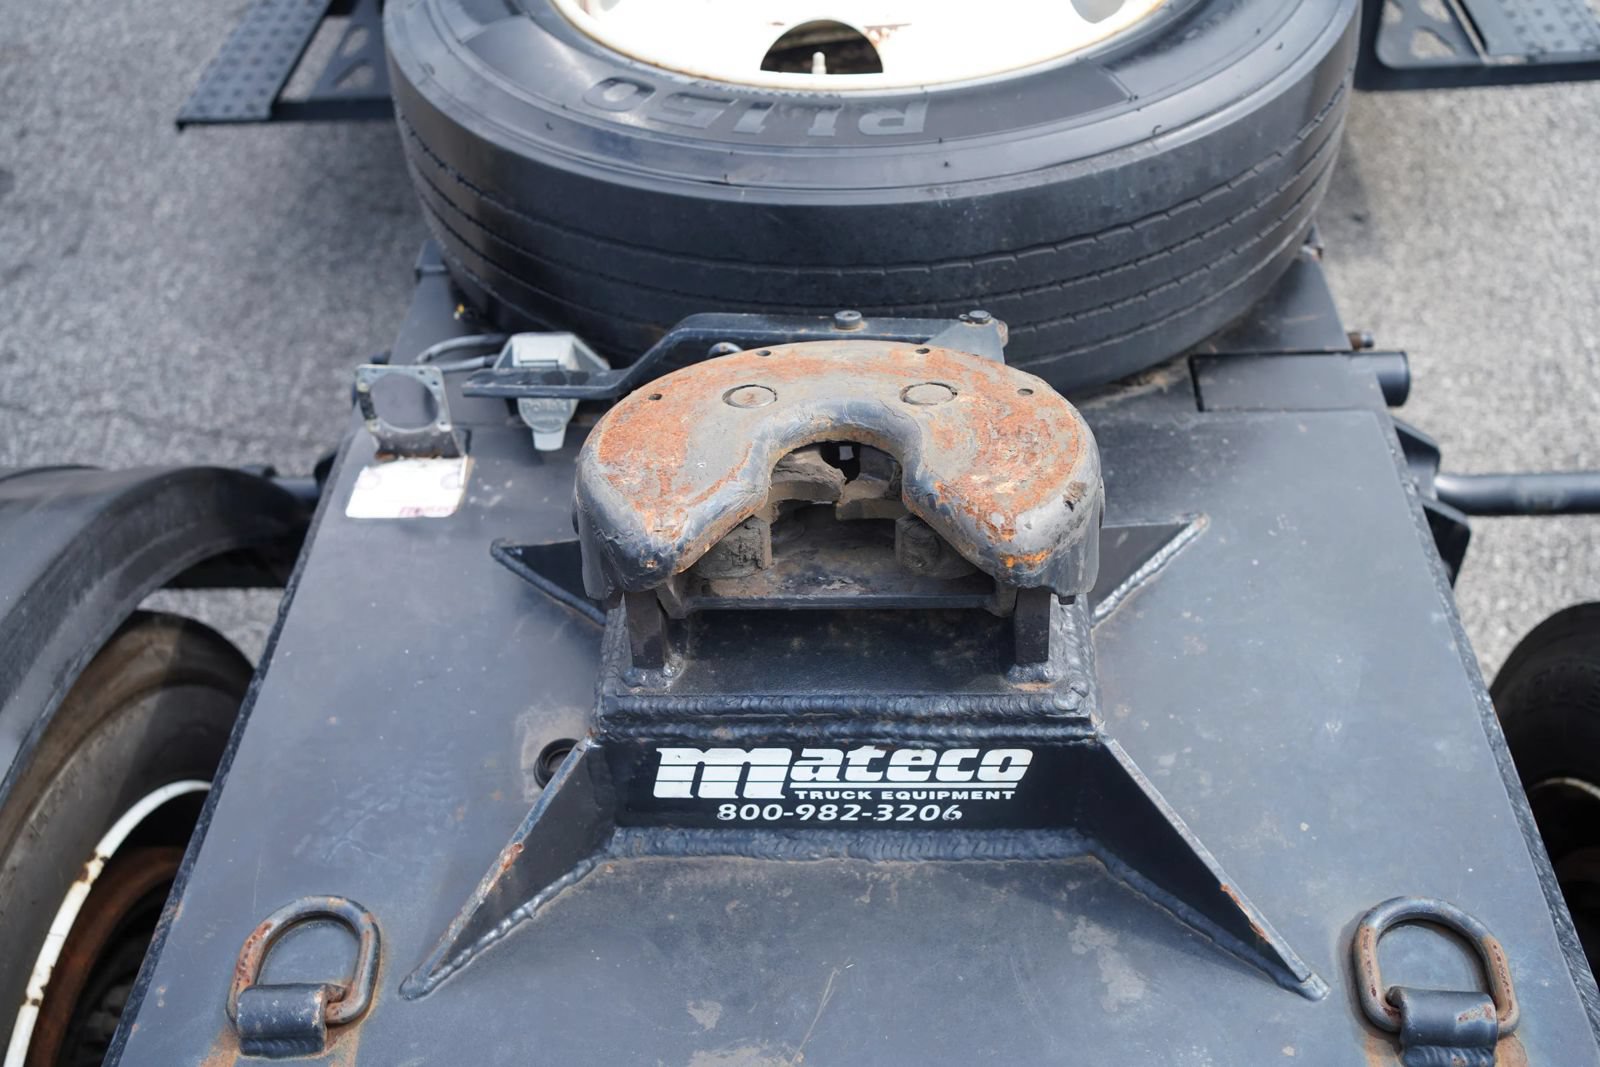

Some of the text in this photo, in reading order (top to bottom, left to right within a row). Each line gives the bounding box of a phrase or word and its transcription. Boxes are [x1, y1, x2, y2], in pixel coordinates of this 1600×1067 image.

[653, 745, 1033, 799] mateco
[795, 790, 1015, 800] TRUCK EQUIPMENT
[716, 803, 963, 822] 800-982-3206
